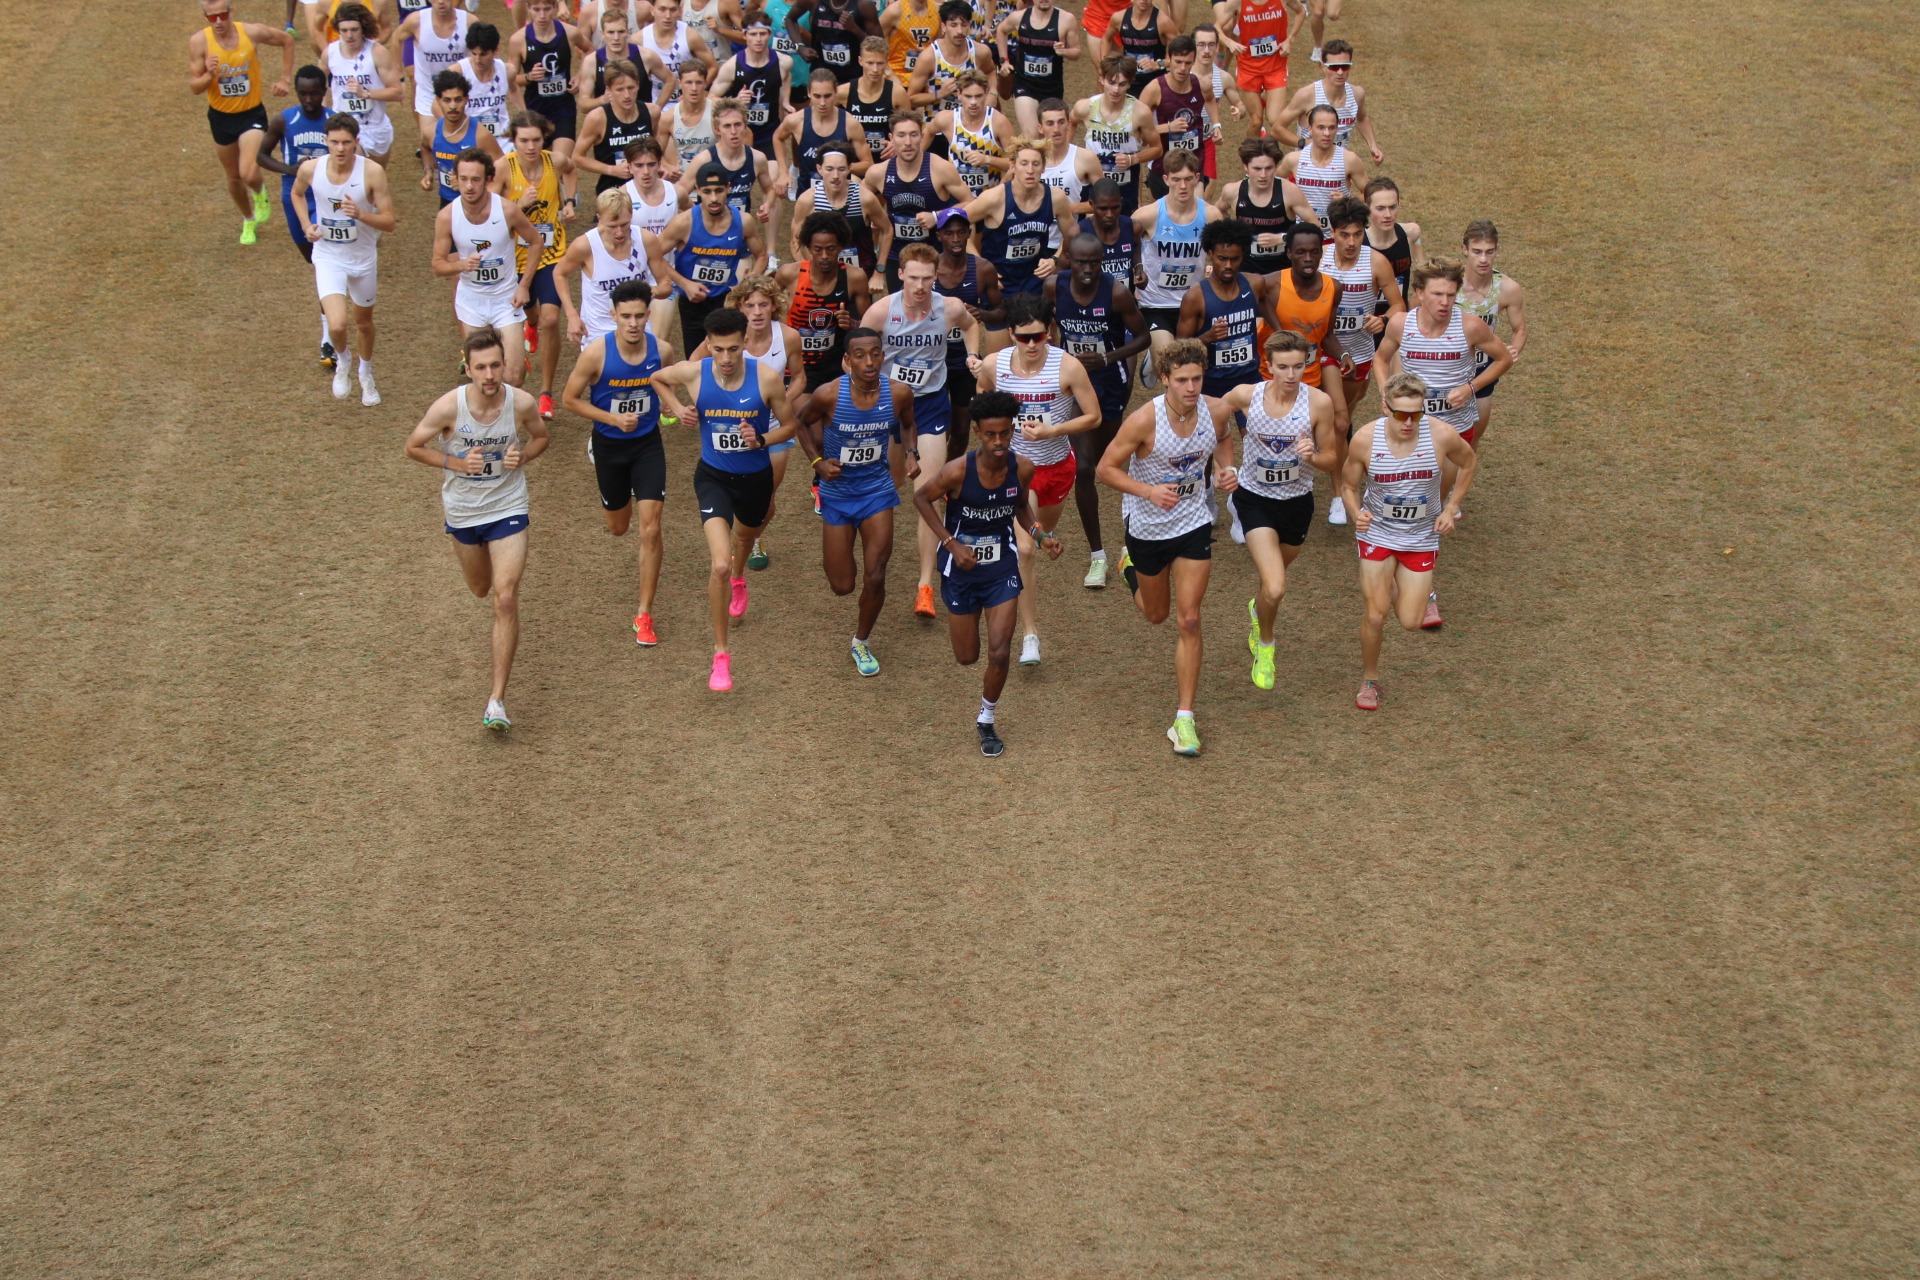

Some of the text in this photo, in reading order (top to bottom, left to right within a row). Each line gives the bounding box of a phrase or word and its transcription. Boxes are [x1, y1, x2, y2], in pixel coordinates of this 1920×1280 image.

[1243, 10, 1282, 23] MILLIGAN
[1254, 42, 1274, 54] 705
[826, 52, 846, 63] 649
[1028, 63, 1048, 74] 646
[333, 74, 372, 87] TAYOR
[223, 83, 247, 95] 595
[542, 82, 563, 94] 536
[348, 98, 368, 110] 847
[468, 95, 506, 108] TAYLOR
[294, 131, 327, 147] VOORHE
[676, 136, 710, 146] MONTREAT
[867, 138, 881, 148] 55
[1092, 130, 1129, 143] EASTERN
[1101, 142, 1121, 150] OREGON
[961, 174, 984, 186] 836
[328, 228, 350, 240] 791
[900, 225, 923, 237] 623
[692, 246, 737, 256] MADONNA
[1011, 245, 1036, 257] 555
[1157, 240, 1201, 259] MVNU
[476, 268, 498, 281] 790
[698, 267, 725, 282] 683
[1165, 273, 1188, 286] 736
[1060, 319, 1108, 334] SPARTANS
[1227, 322, 1252, 337] LLEGE
[803, 337, 830, 349] 654
[887, 334, 943, 347] CORBAN
[1073, 343, 1098, 354] 867
[1221, 349, 1248, 364] 553
[897, 367, 925, 384] 557
[618, 399, 644, 413] 681
[705, 409, 758, 418] MADONNA
[839, 421, 889, 432] OKLAHOMA
[462, 435, 509, 448] MONTREAT
[719, 434, 748, 449] 682
[848, 447, 875, 461] 739
[1265, 469, 1290, 482] 611
[1374, 470, 1433, 483] CUMBERLANDS
[1176, 482, 1195, 496] 04
[962, 504, 1015, 521] SPARTANS
[1391, 506, 1418, 519] 577
[975, 545, 994, 561] 68
